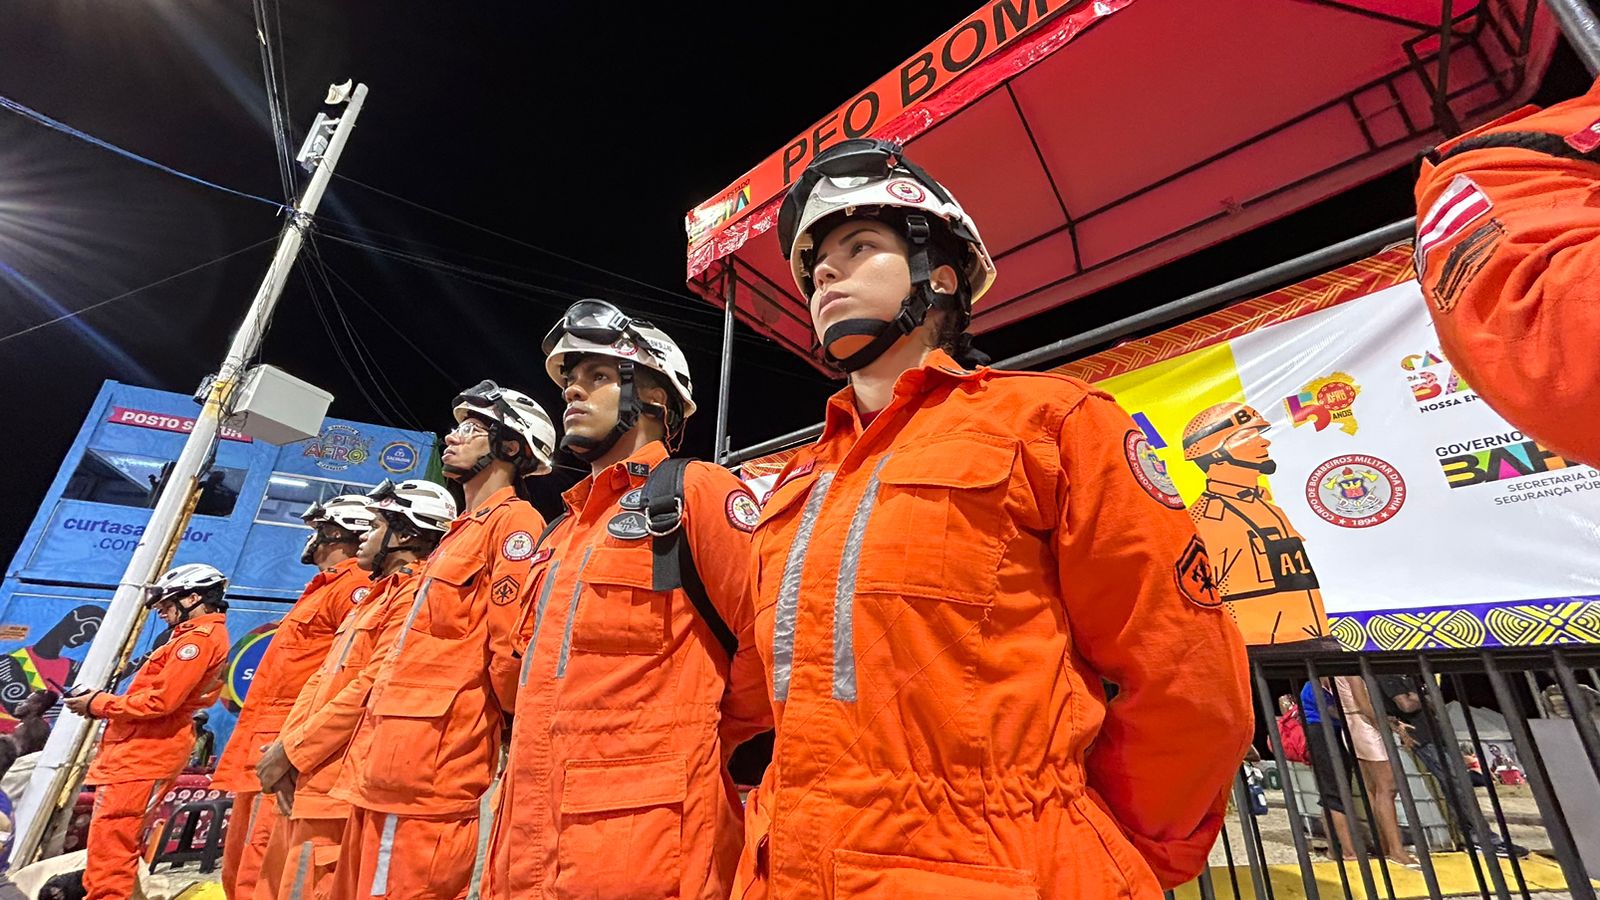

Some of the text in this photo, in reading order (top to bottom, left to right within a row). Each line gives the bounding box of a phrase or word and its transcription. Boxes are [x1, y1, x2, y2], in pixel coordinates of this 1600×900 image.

[899, 0, 1048, 108] BOM
[1333, 409, 1353, 419] ANOS
[1420, 398, 1462, 413] NOSSA
[121, 411, 180, 429] POSTO
[1435, 431, 1524, 457] GOVERNO
[1308, 456, 1404, 521] CORPO DE BOMBEIROS MILITAR DA BAHIA
[1507, 470, 1600, 492] SECRETARIA D
[1494, 486, 1572, 505] SEGURANÇA
[63, 517, 214, 543] curtasador
[1351, 516, 1378, 526] 1894
[1280, 550, 1311, 577] A1
